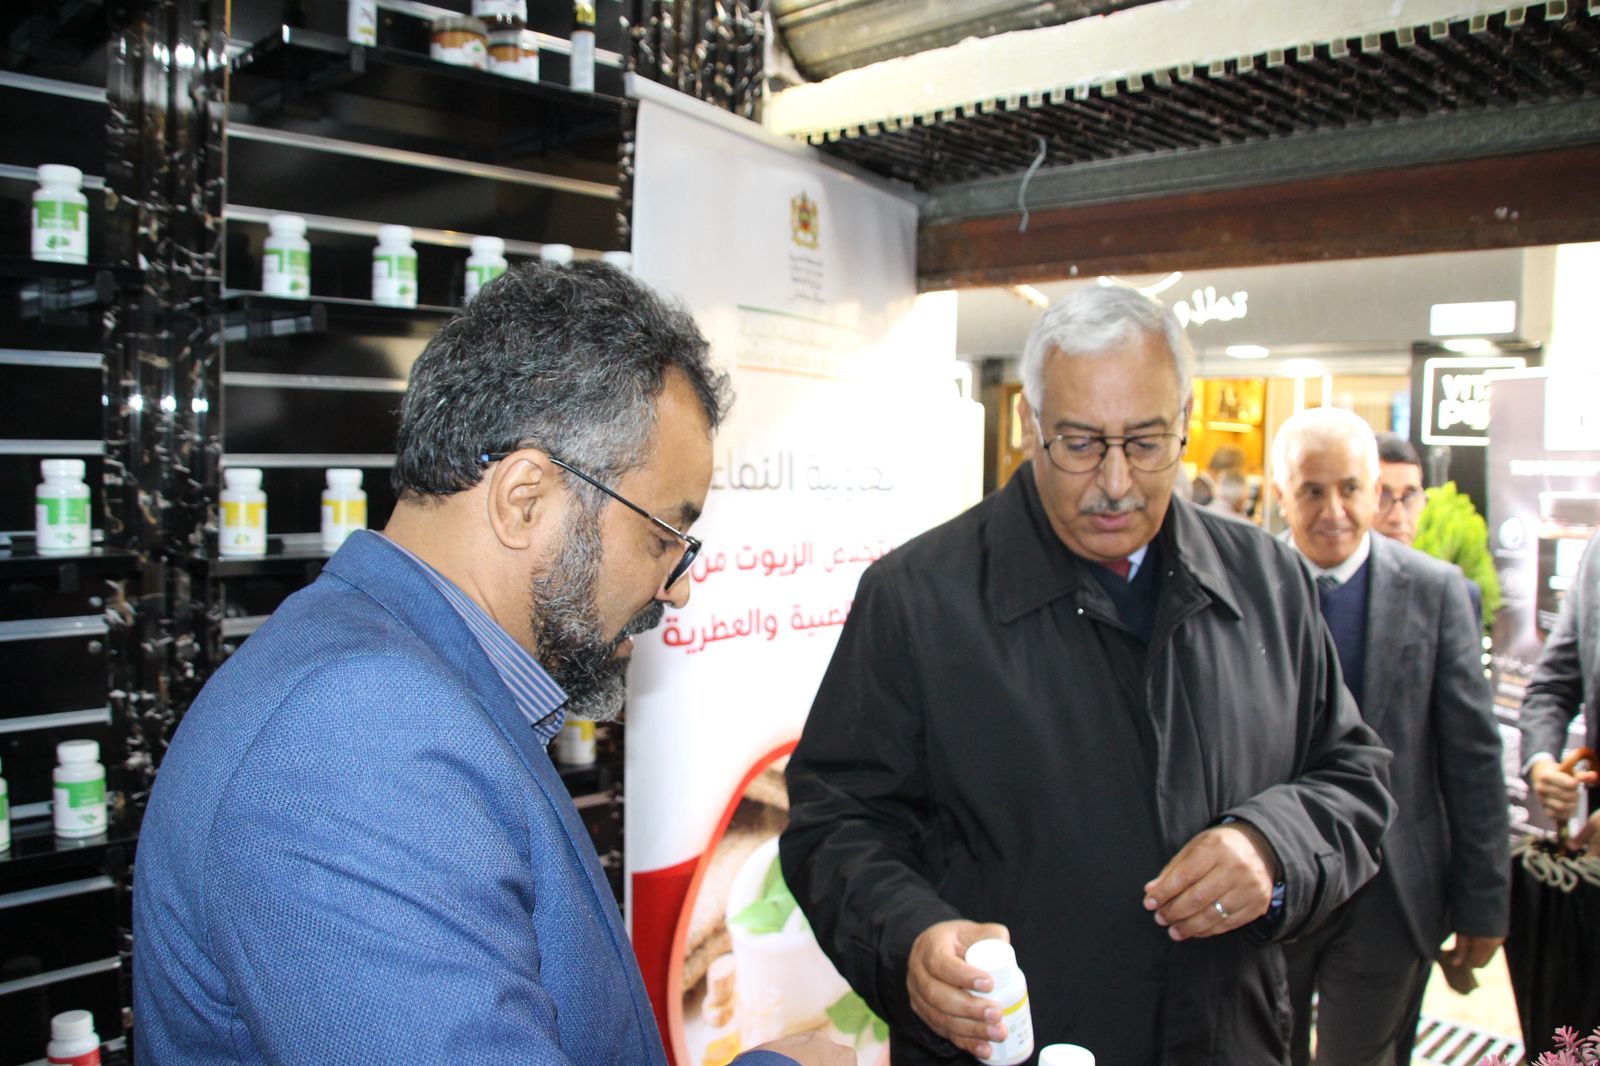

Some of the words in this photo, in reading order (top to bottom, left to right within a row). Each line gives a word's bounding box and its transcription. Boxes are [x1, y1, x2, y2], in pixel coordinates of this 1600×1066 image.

[690, 551, 727, 584] من
[736, 542, 813, 577] الزيوت
[661, 607, 779, 656] والعطرية
